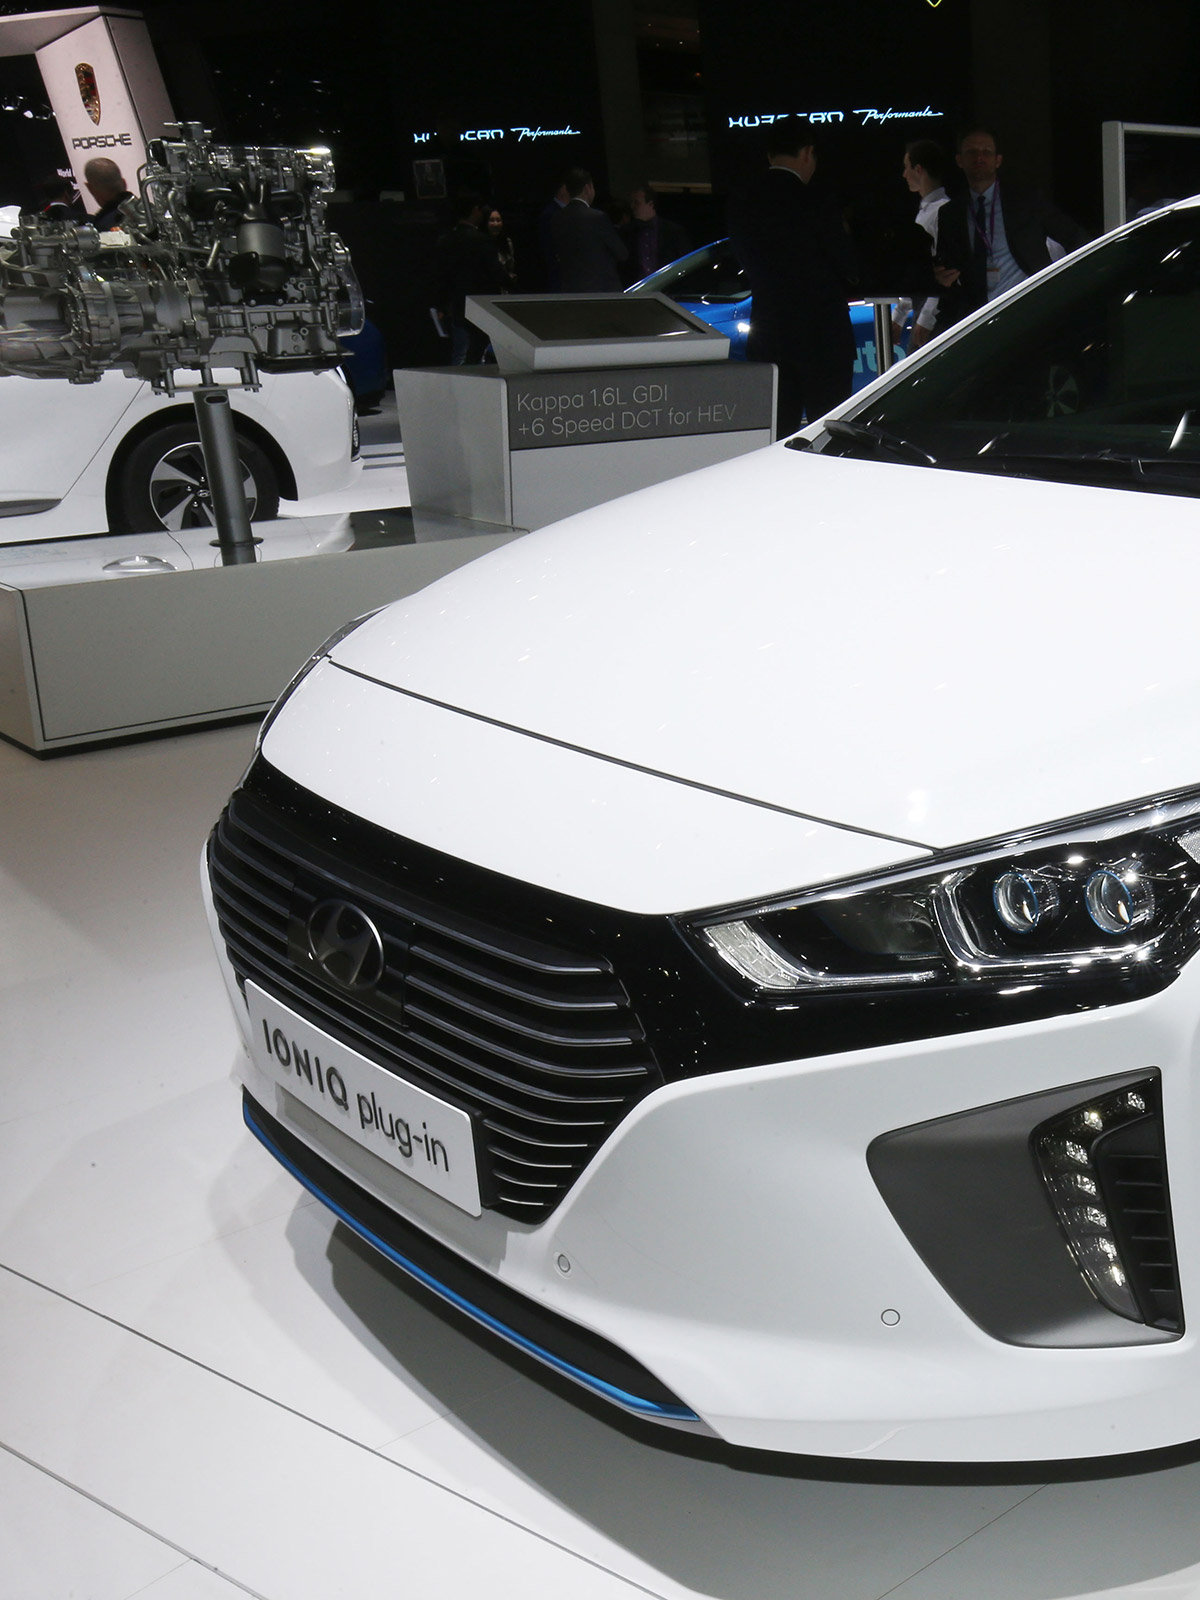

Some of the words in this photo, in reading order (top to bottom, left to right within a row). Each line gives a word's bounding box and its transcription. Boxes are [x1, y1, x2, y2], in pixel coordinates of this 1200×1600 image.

[852, 105, 944, 126] Performante
[72, 133, 132, 150] PORSCHE
[510, 125, 581, 142] Performante
[517, 392, 584, 414] Kappa
[589, 387, 627, 407] 1.6L
[632, 384, 668, 404] GDI
[518, 418, 545, 437] +6
[551, 413, 615, 438] Speed
[621, 408, 663, 430] DCT
[668, 407, 692, 425] for
[698, 404, 737, 423] HEV
[262, 1018, 349, 1111] IONIQ
[356, 1091, 449, 1172] plug-in
